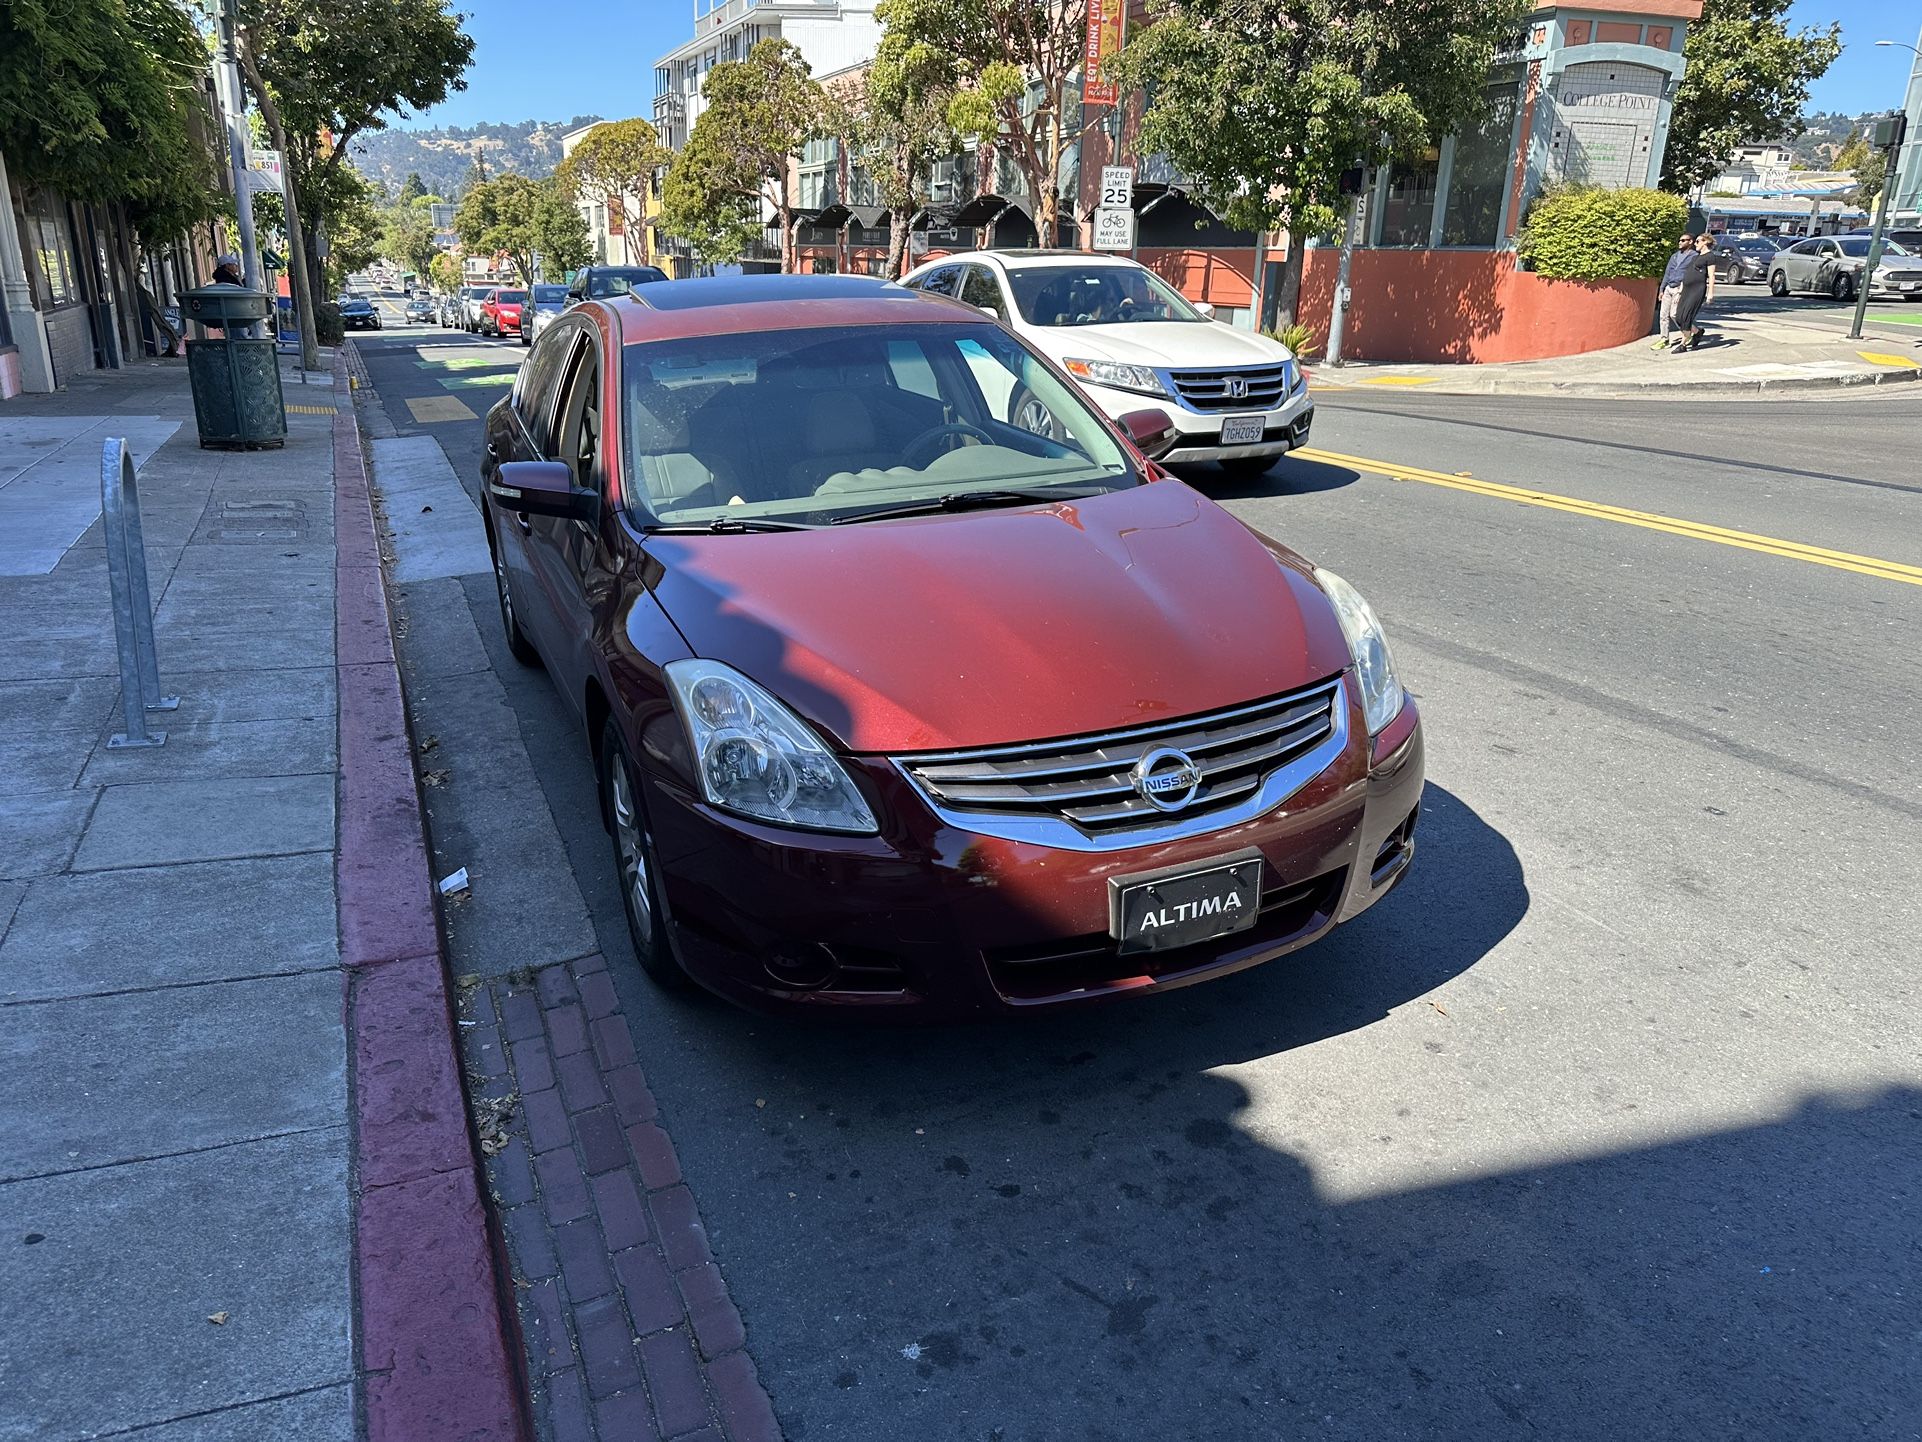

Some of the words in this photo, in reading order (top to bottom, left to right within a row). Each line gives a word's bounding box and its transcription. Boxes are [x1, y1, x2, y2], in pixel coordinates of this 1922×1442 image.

[1090, 0, 1101, 20] LIV
[1089, 24, 1099, 58] DRINK
[1564, 91, 1616, 108] COLLEGE
[1618, 94, 1655, 110] POINT
[261, 161, 273, 169] 851
[1105, 189, 1128, 204] 25
[1226, 427, 1261, 440] 7GHZ059
[1145, 773, 1198, 791] NISSAN
[1139, 891, 1242, 932] ALTIMA
